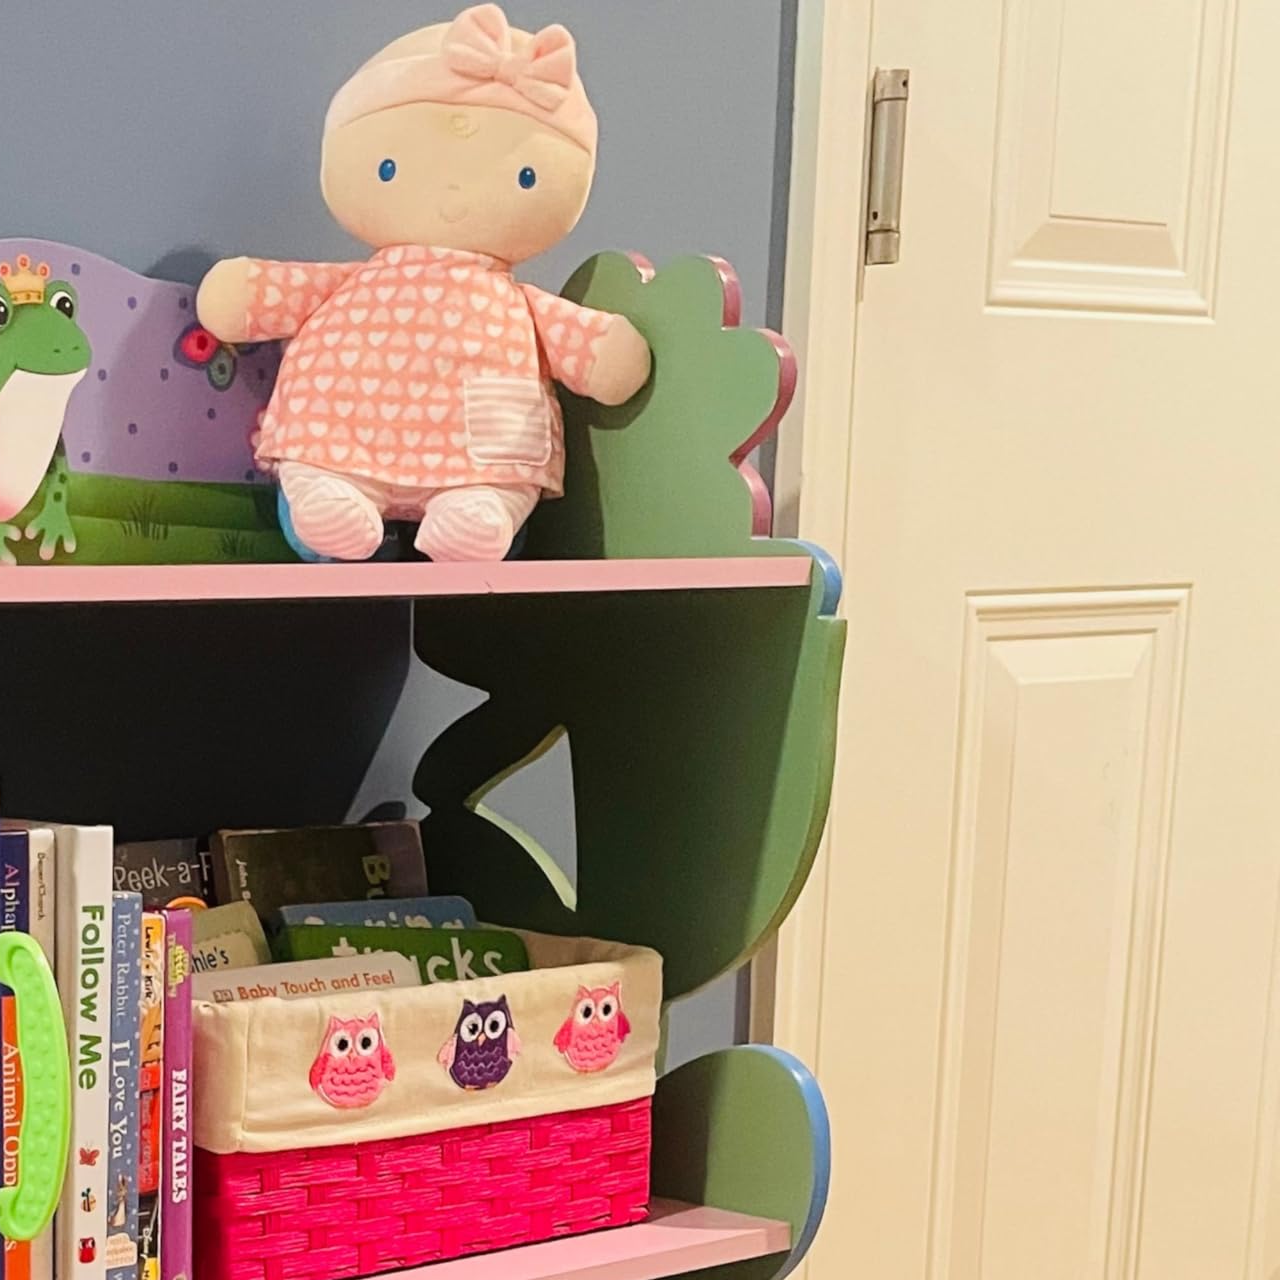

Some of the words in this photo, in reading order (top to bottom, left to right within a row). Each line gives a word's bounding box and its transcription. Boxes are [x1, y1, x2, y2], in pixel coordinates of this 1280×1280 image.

[116, 913, 132, 954] Peter
[80, 905, 105, 1022] Follow
[116, 962, 131, 1017] Rabbit
[237, 984, 277, 1000] Baby
[281, 978, 327, 996] Touch
[332, 974, 360, 991] and
[364, 969, 395, 987] Feel
[79, 1034, 102, 1090] Me
[111, 1040, 131, 1053] I
[2, 1041, 21, 1128] Animal
[111, 1057, 131, 1112] Love
[171, 1068, 188, 1131] FAIRY
[110, 1116, 128, 1159] You
[171, 1136, 188, 1204] TALES
